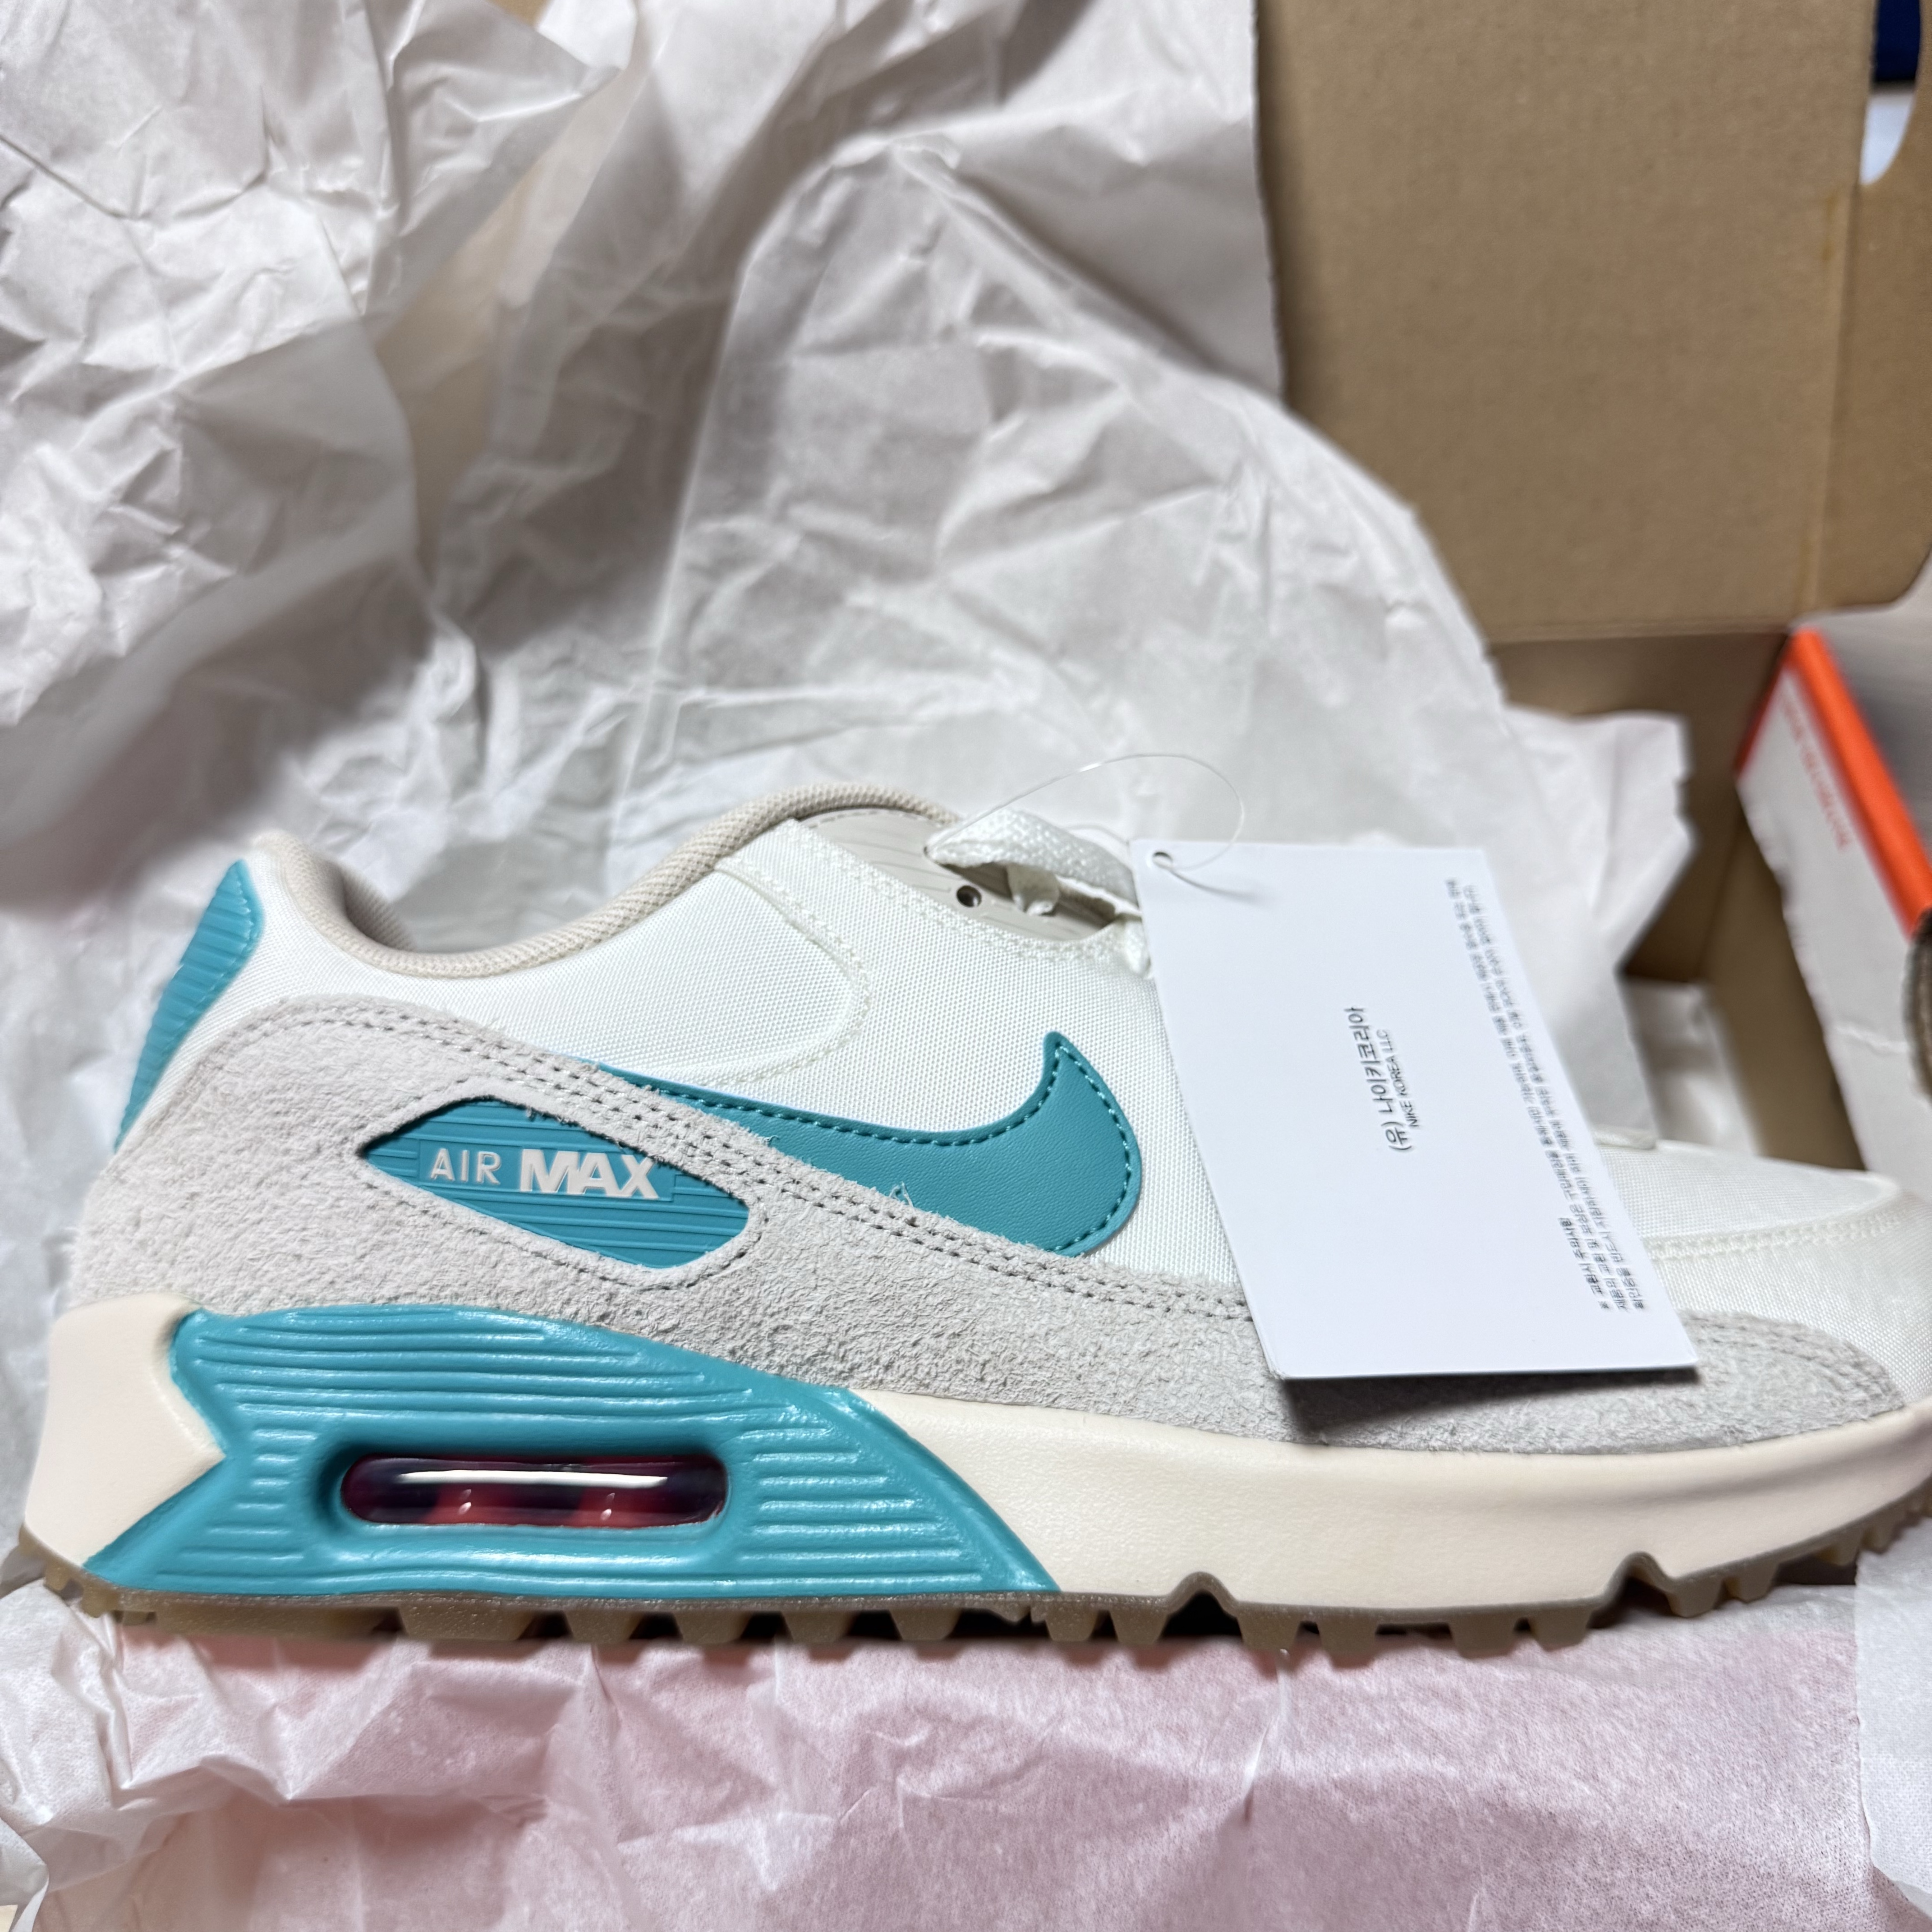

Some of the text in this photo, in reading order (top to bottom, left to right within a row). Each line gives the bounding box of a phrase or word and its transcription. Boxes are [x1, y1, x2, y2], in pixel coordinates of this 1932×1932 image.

[1343, 1005, 1412, 1152] (유) 나이키코리아
[1375, 1028, 1419, 1127] NIKE KOREA LLC
[430, 1148, 659, 1200] AIR MAX
[1558, 1218, 1583, 1258] 주의사항
[1578, 1263, 1603, 1295] 교환시
[1592, 1253, 1610, 1274] 교환
[1604, 1278, 1628, 1310] 제품의
